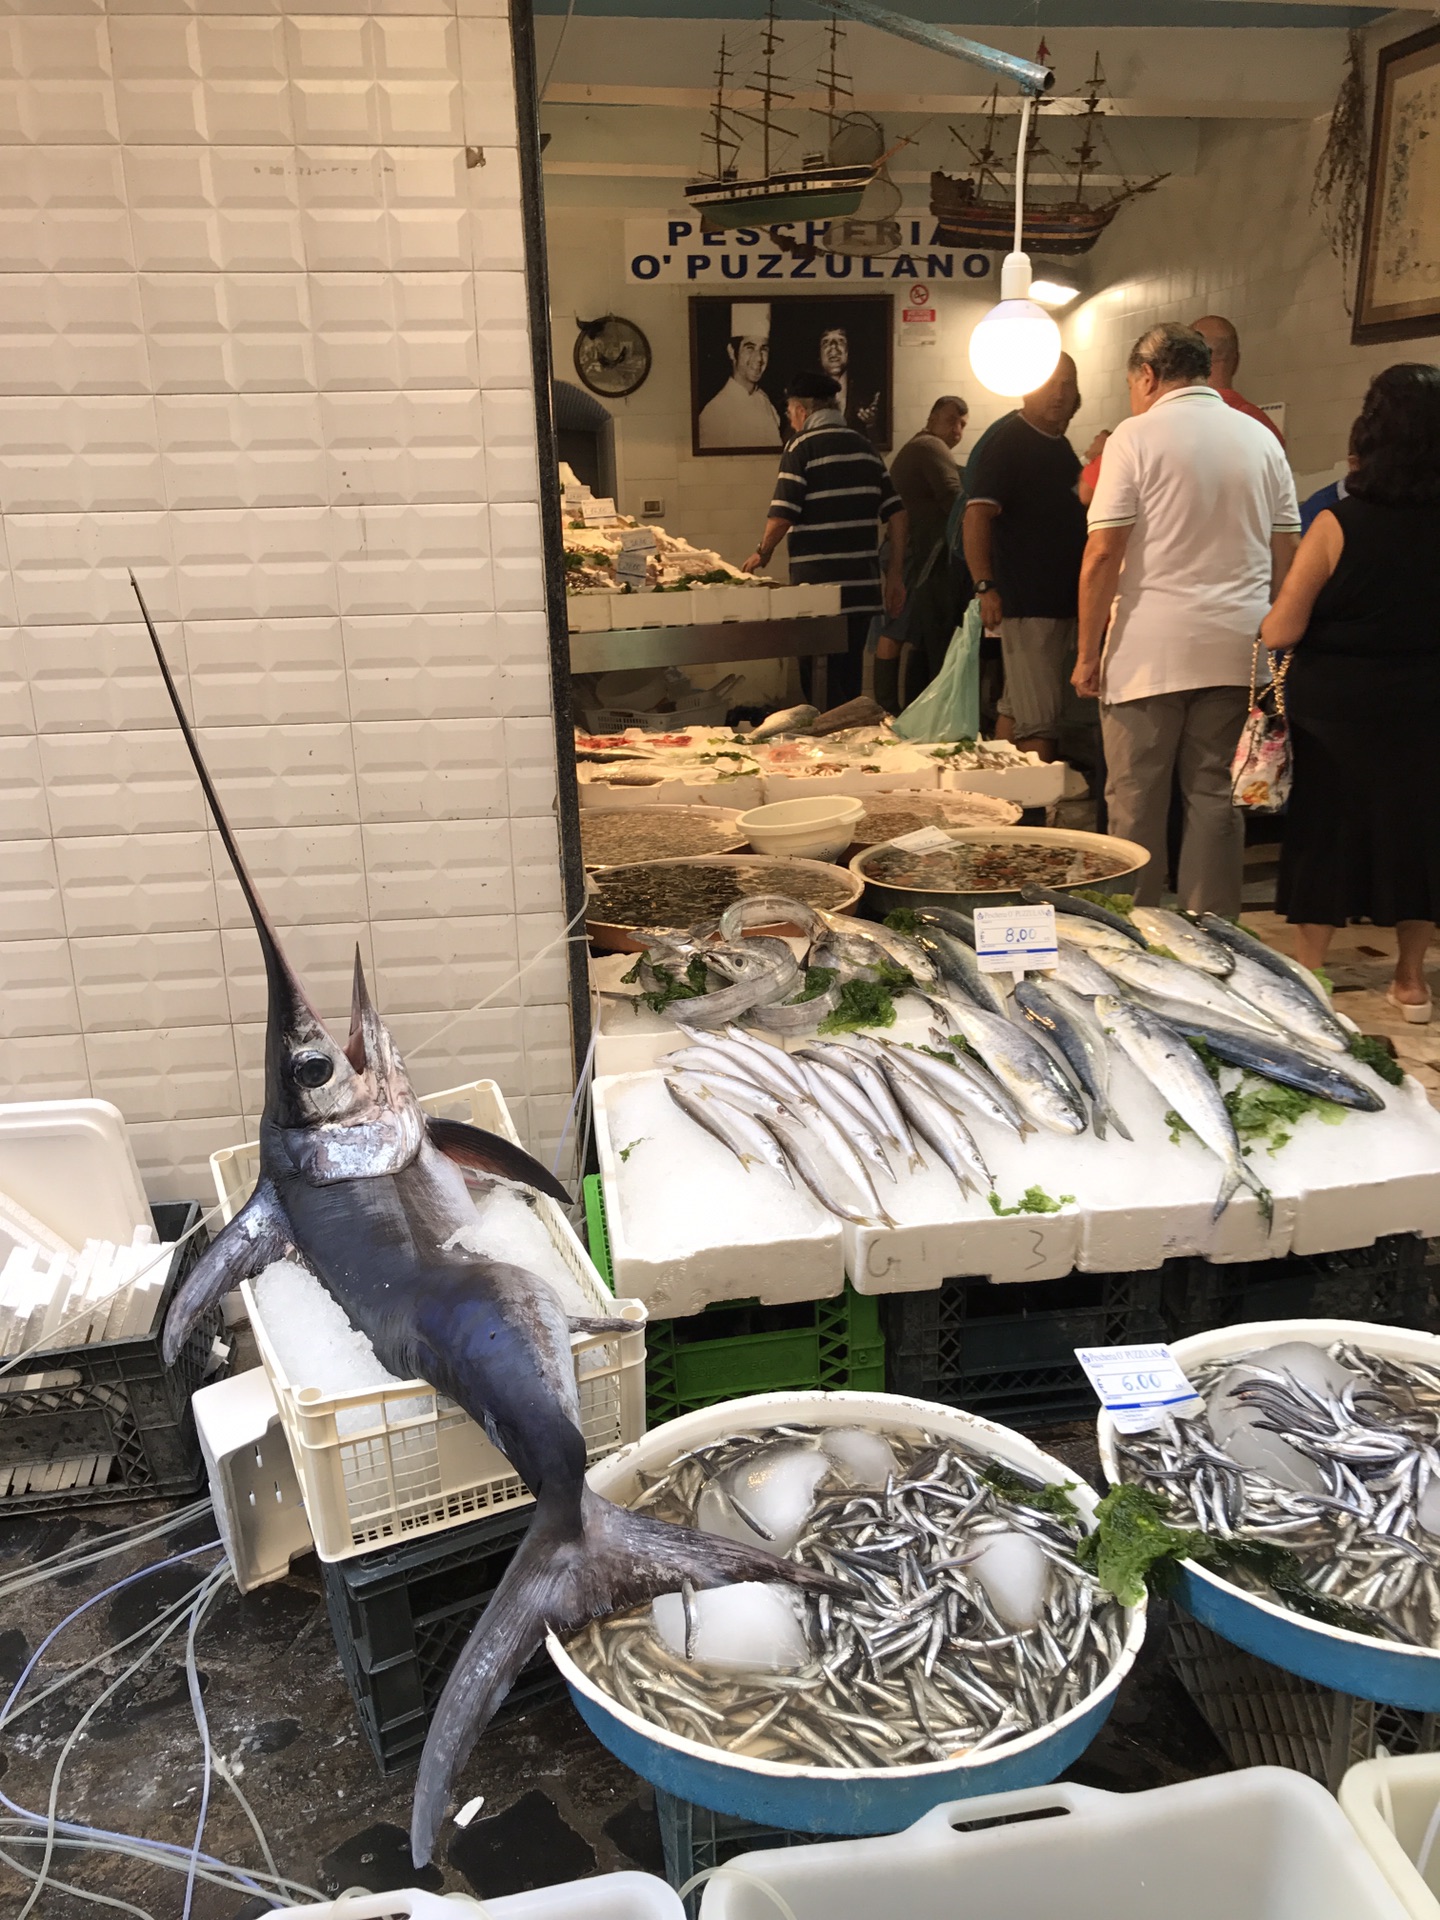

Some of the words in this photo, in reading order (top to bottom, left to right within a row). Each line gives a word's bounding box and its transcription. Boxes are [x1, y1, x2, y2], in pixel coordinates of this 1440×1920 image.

[631, 254, 671, 280] O'
[687, 253, 991, 279] PUZZULANO
[1005, 927, 1037, 943] 8.00
[1121, 1373, 1161, 1392] 6.00
